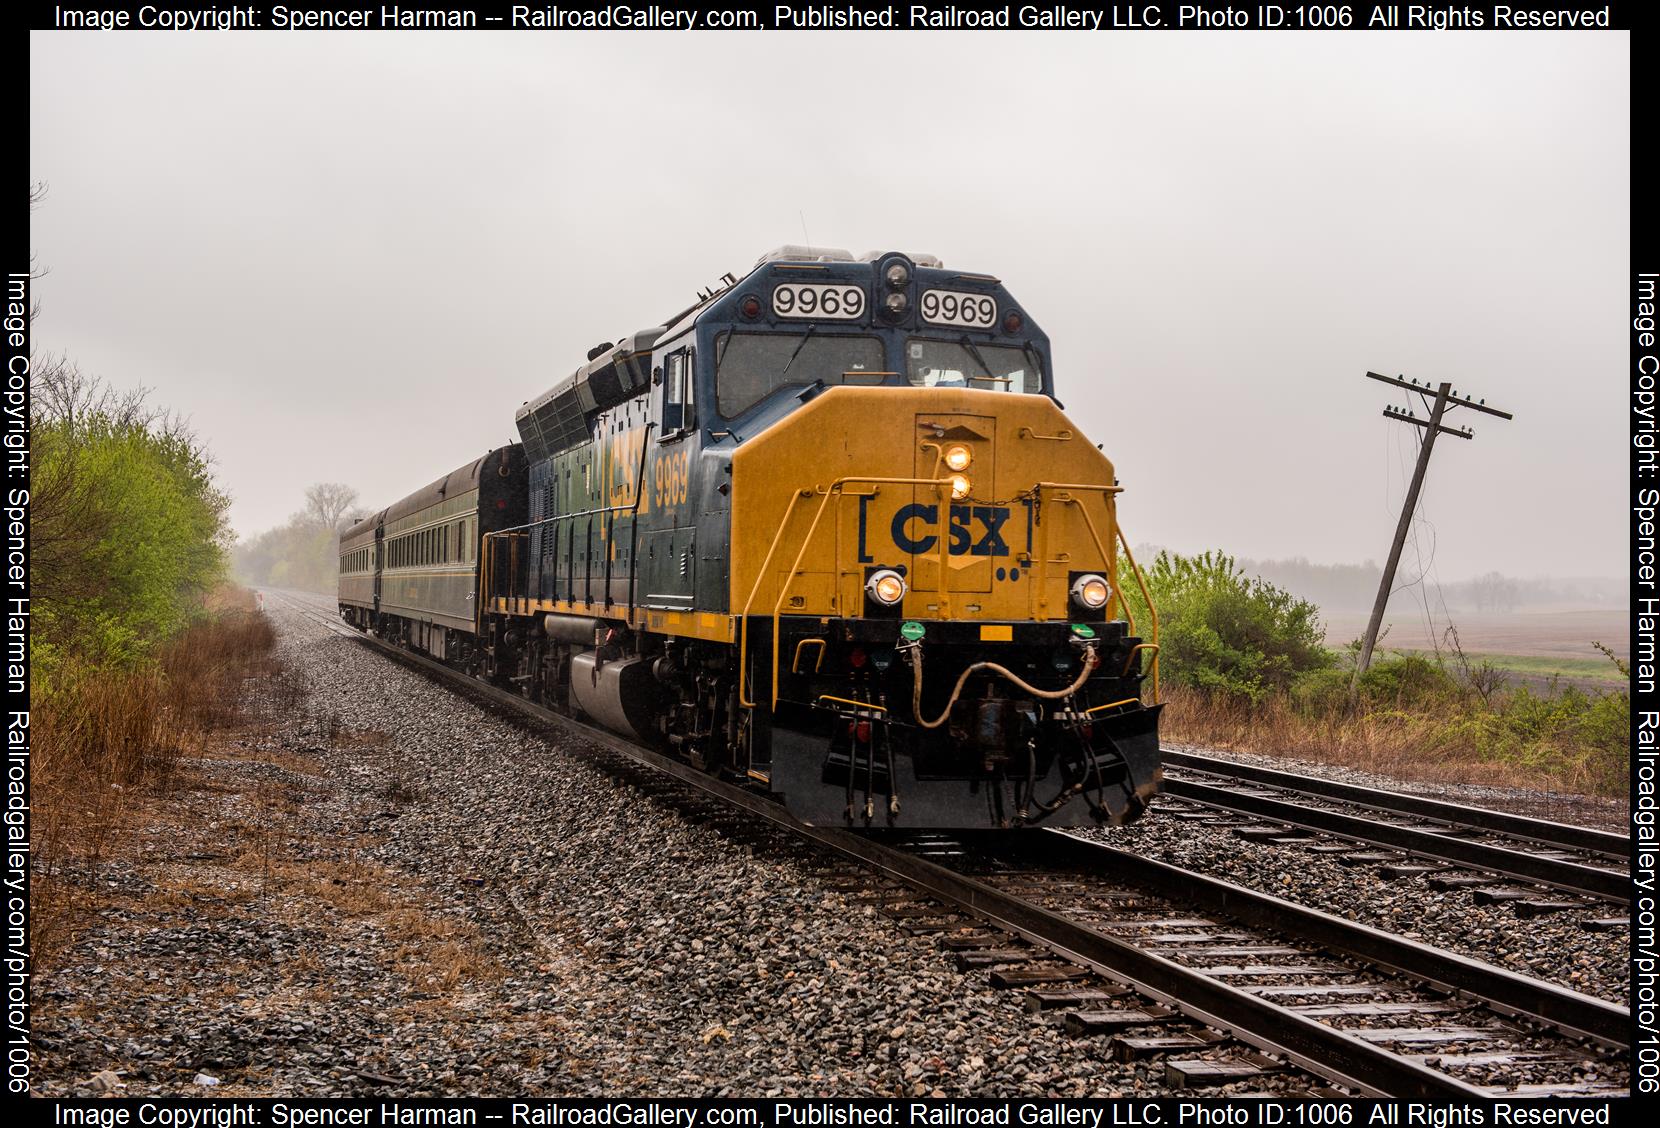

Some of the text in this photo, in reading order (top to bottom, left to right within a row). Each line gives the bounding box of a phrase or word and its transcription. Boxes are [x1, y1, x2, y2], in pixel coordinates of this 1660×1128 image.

[775, 287, 863, 315] 9969
[923, 293, 994, 325] 9969
[655, 450, 687, 508] 9969
[891, 503, 1010, 556] CSX
